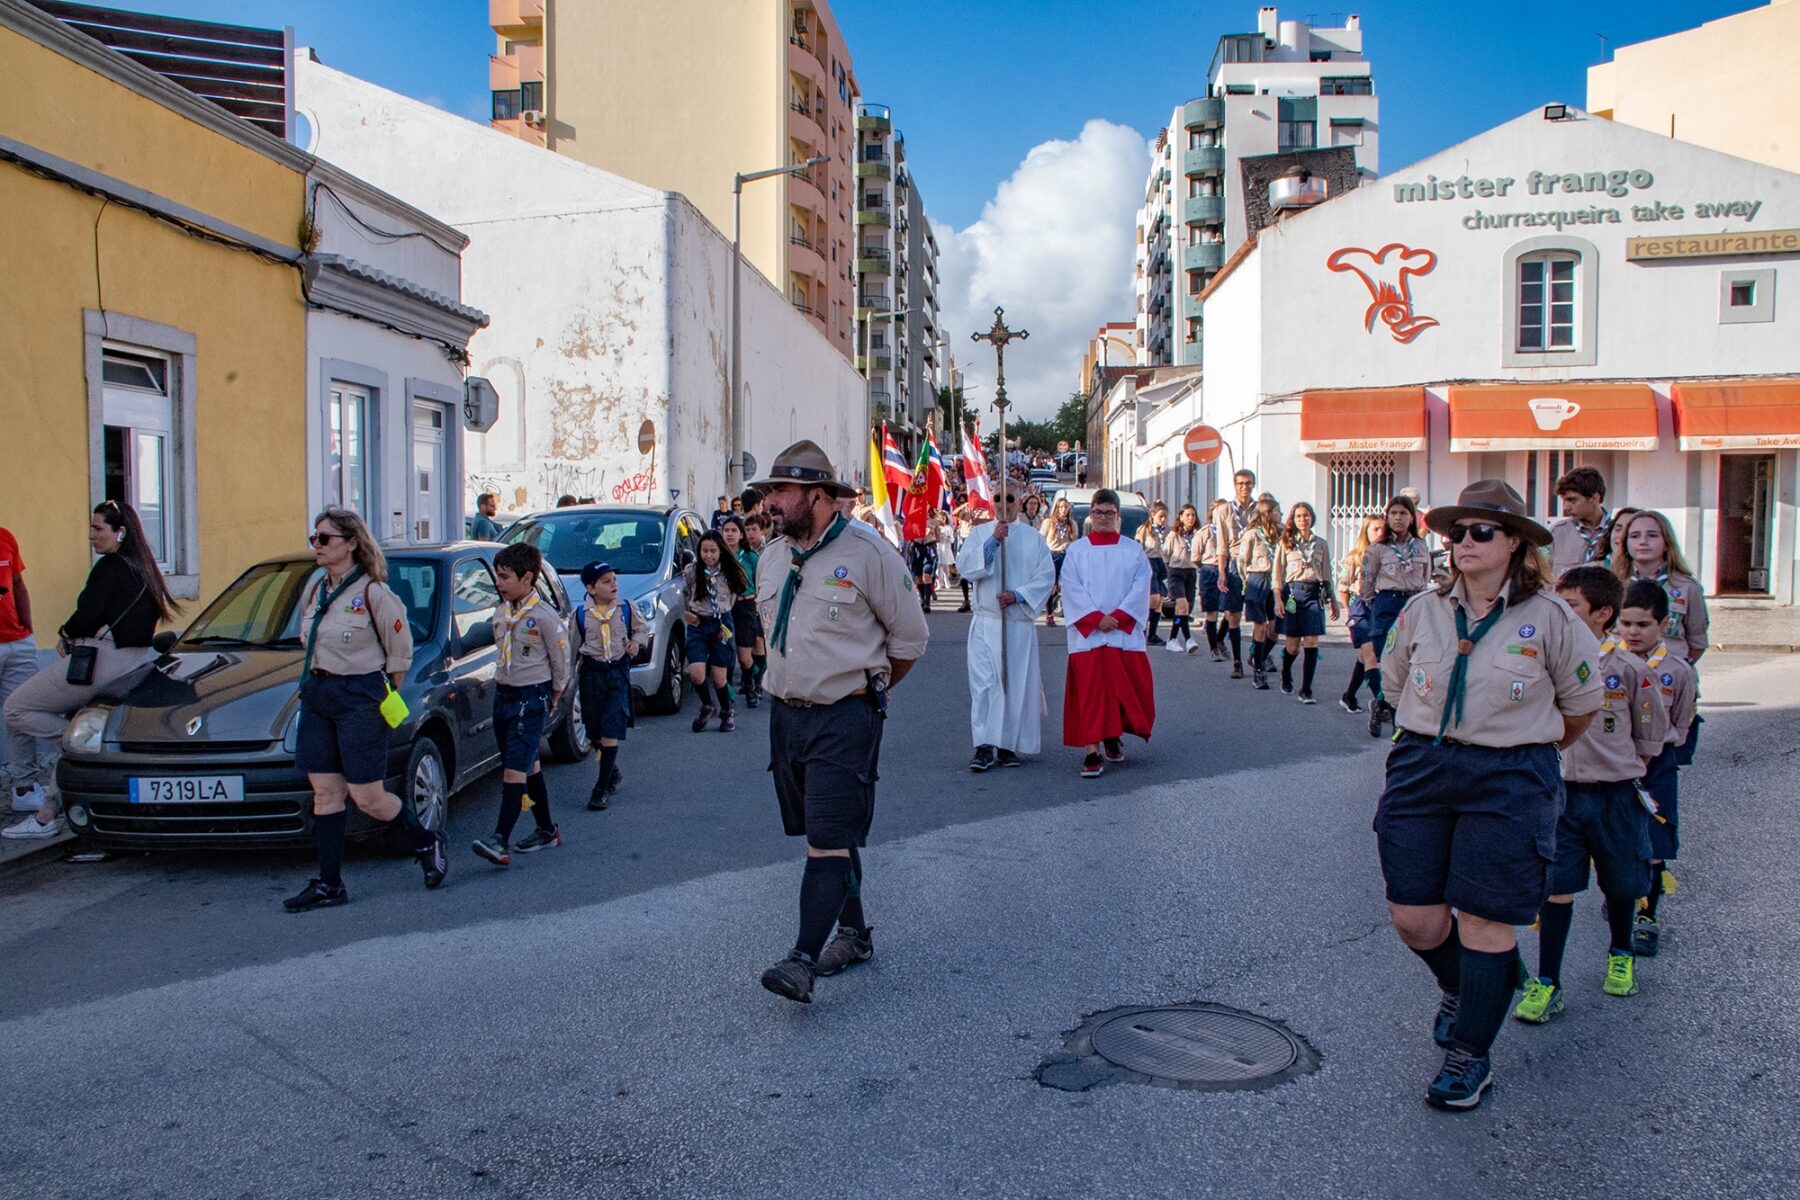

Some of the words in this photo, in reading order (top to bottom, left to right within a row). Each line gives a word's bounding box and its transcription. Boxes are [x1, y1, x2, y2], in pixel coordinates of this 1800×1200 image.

[1394, 174, 1515, 203] mister
[1527, 169, 1654, 197] frango
[1462, 204, 1621, 231] churrasqueira
[1631, 200, 1684, 222] take
[1695, 200, 1762, 222] away
[1634, 233, 1798, 256] restaurante
[1349, 441, 1377, 449] Mister
[1380, 440, 1413, 449] Frango
[1575, 439, 1645, 449] Churrasqueira
[1756, 437, 1779, 446] Take
